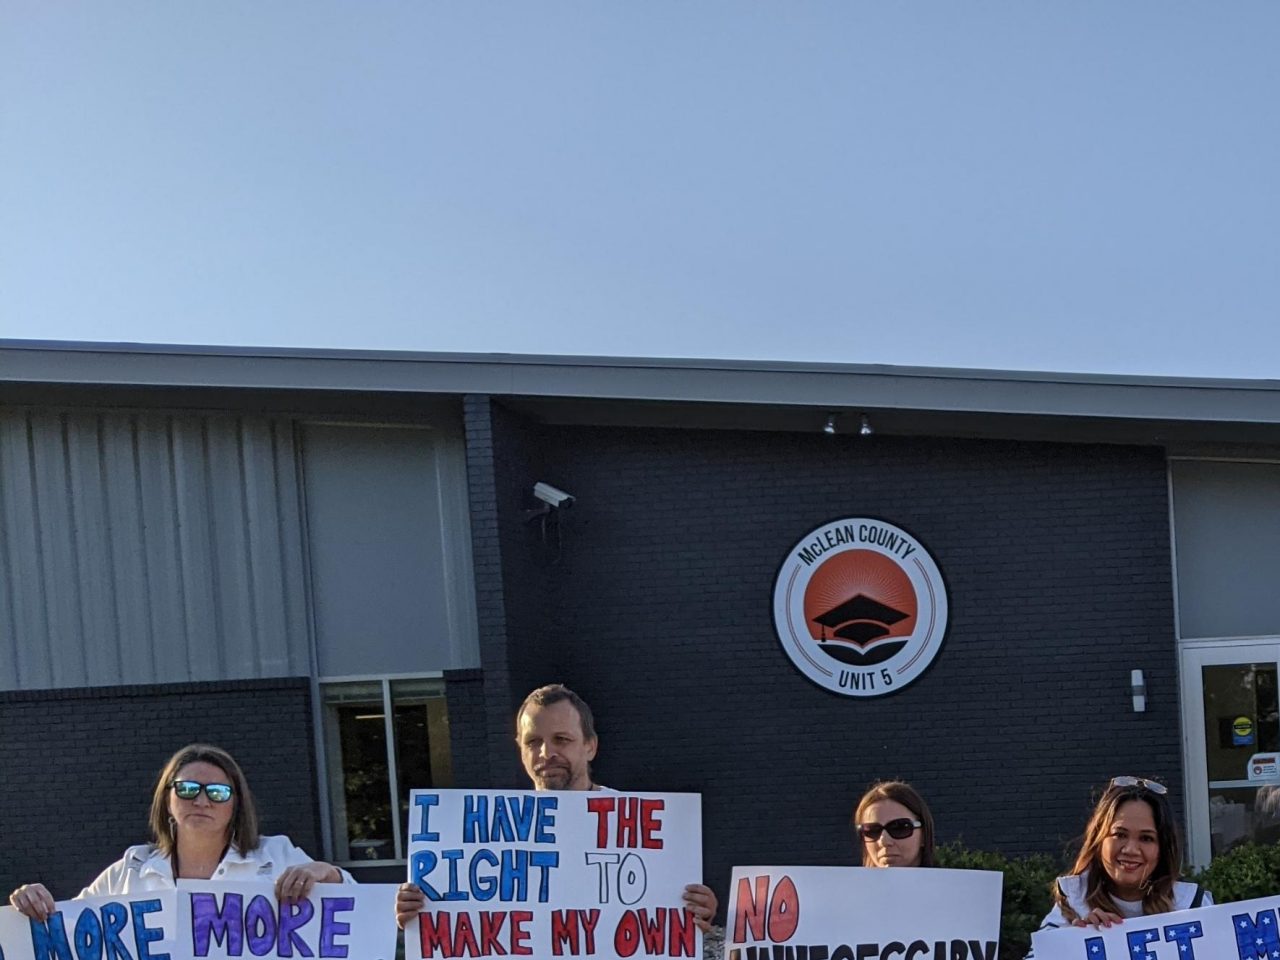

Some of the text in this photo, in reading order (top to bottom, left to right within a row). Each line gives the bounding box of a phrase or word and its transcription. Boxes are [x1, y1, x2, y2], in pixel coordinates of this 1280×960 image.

[859, 524, 916, 560] COUNTY
[839, 668, 894, 690] UNIT 5
[412, 794, 665, 849] I HAVE THE
[410, 848, 647, 905] RIGHT TO
[190, 892, 355, 958] MORE
[418, 907, 696, 959] MAKE MY OWN
[733, 875, 799, 943] NO
